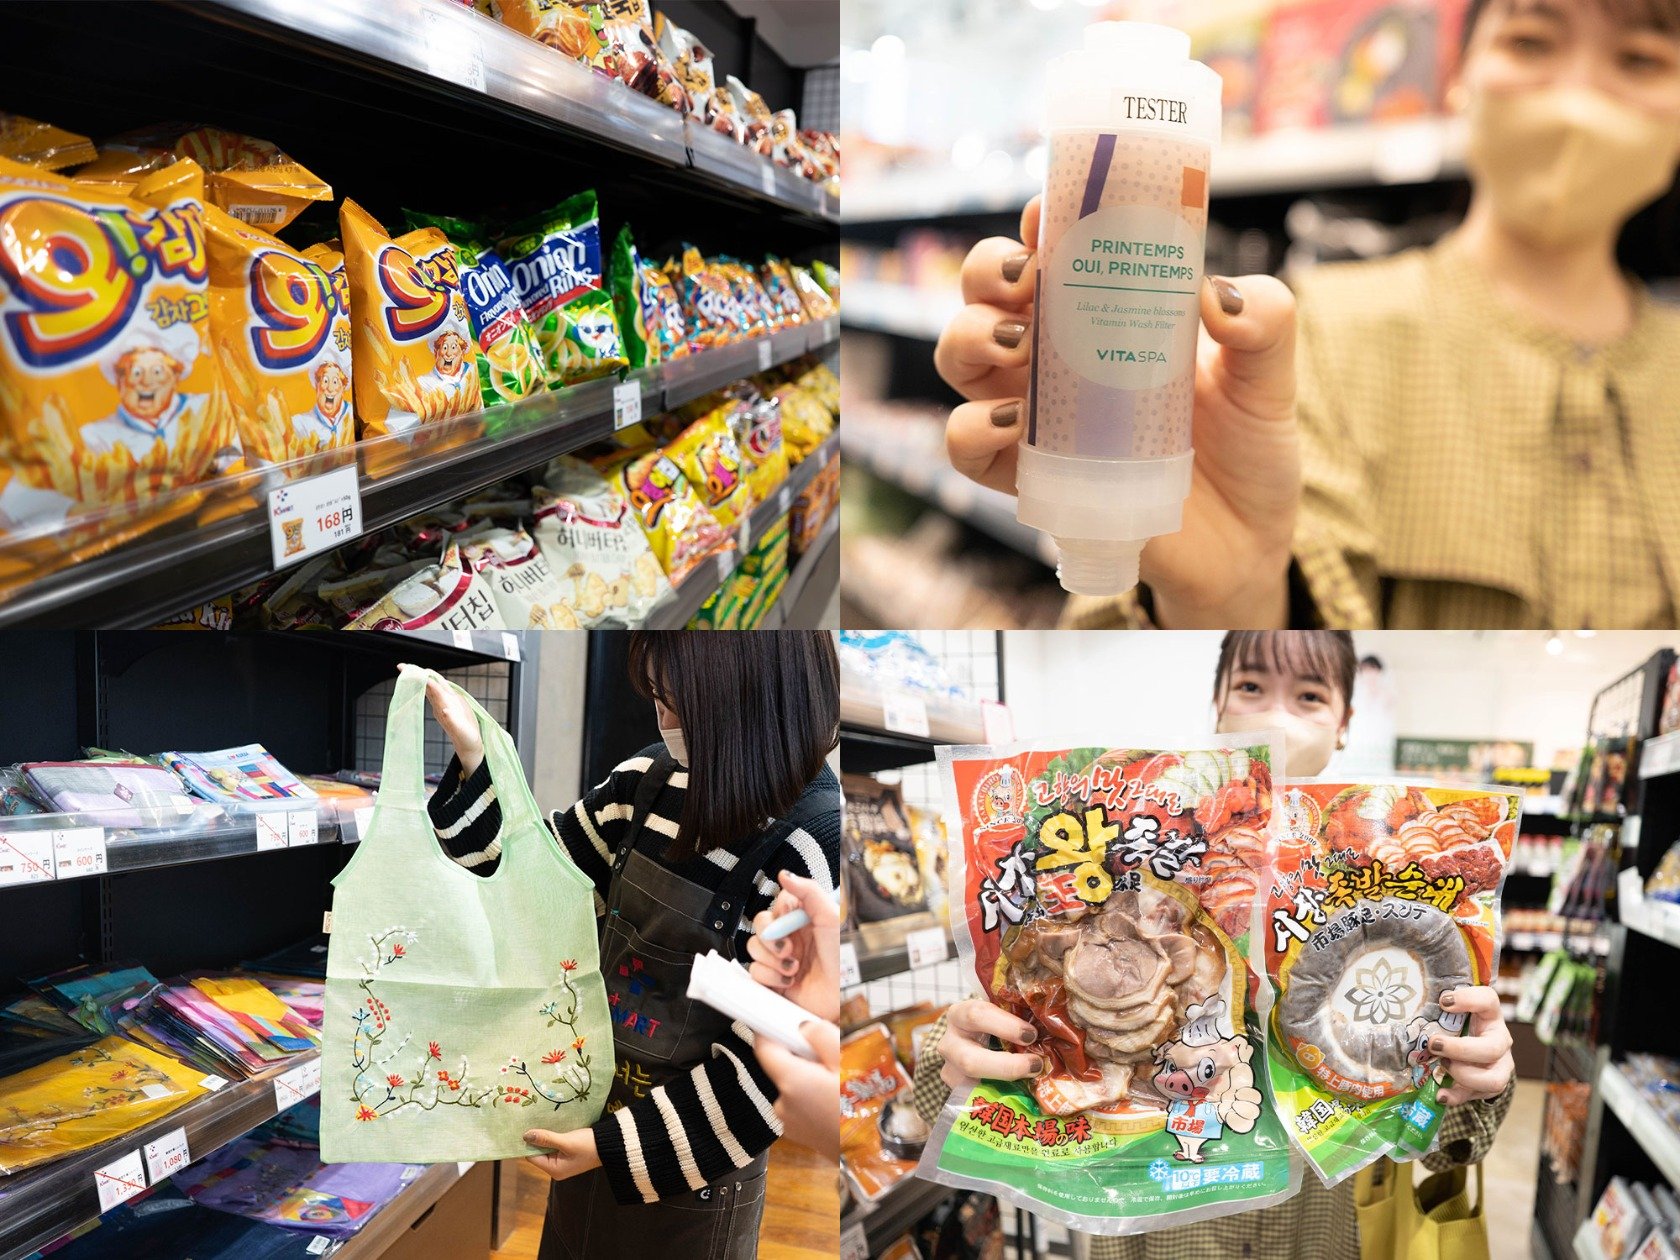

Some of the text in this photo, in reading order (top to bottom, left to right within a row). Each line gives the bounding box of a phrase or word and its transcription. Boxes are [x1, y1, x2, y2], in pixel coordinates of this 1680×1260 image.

[1123, 96, 1187, 124] TESTER
[1091, 239, 1184, 260] PRINTEMPS
[512, 241, 586, 297] Onion
[1072, 258, 1194, 280] OUI, PRINTEMPS
[1076, 301, 1100, 312] Lilac
[1101, 304, 1110, 313] &
[1110, 304, 1151, 316] Jasmine
[1091, 317, 1176, 330] Vitamin Wash Filter
[1096, 349, 1167, 363] VITASPA
[1034, 765, 1182, 817] 고향의 맛 그대로
[970, 1096, 1092, 1147] 韓国本場の味
[1171, 1116, 1205, 1134] 市場
[1294, 1099, 1335, 1133] 韓国
[1203, 1163, 1261, 1184] 要冷蔵
